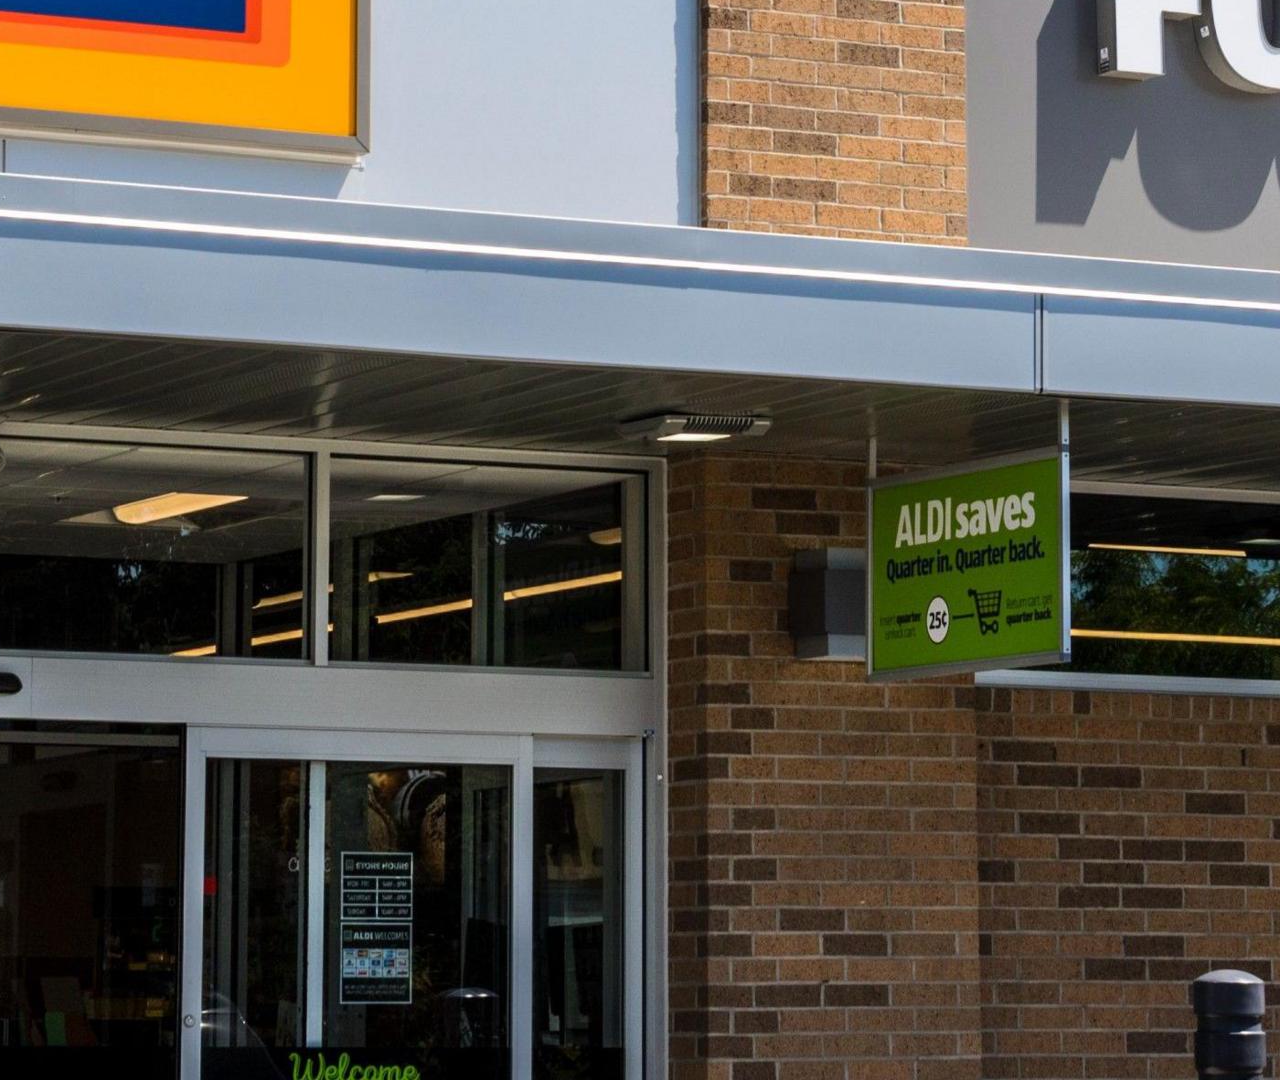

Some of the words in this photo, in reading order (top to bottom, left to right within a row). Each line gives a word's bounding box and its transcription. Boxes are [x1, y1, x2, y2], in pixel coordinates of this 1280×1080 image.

[895, 497, 952, 548] ALDI
[955, 491, 1036, 539] saves
[886, 555, 935, 584] Quarter
[937, 548, 953, 575] in.
[956, 544, 1007, 574] Quarter
[1009, 535, 1046, 562] back.
[896, 612, 922, 627] quarter
[929, 611, 947, 630] 25¢
[1006, 612, 1033, 627] quarter
[1034, 607, 1053, 621] back
[353, 931, 373, 941] ALDI
[374, 931, 409, 941] WELCOMES
[289, 1053, 419, 1080] Welcome
